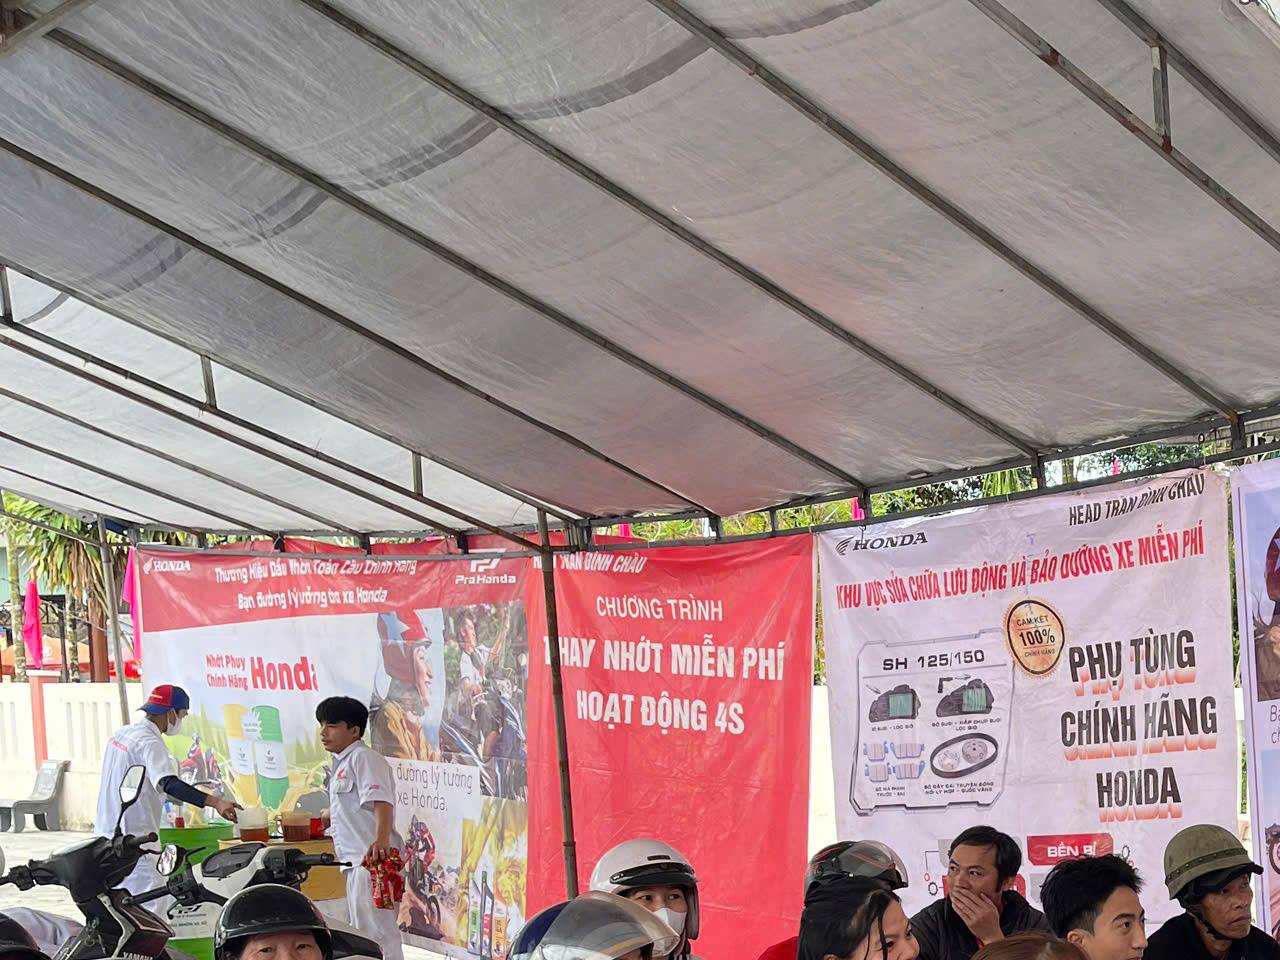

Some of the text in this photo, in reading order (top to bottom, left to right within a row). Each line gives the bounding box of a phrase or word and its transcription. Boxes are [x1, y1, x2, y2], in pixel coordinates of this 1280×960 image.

[1069, 502, 1101, 526] HEAD
[853, 531, 928, 551] HONDA
[836, 520, 1204, 612] KHU VỰC SỬA CHỮA LƯU ĐỘNG VÀ BẢO DƯỠNG XE MIỄN PHÍ
[596, 593, 723, 622] CHƯƠNG TRÌNH
[1019, 627, 1055, 646] 100%
[603, 635, 663, 673] NHỚT
[671, 634, 735, 678] MIỄN
[743, 642, 785, 681] PHÍ
[883, 649, 985, 671] SH 125/150
[1069, 628, 1196, 686] PHỤ TÙNG
[576, 690, 745, 735] HOẠT ĐỘNG 4S
[1061, 692, 1217, 747] CHÍNH HÃNG
[430, 763, 440, 790] lý
[1096, 767, 1182, 808] HONDA
[1047, 841, 1079, 858] BỀN
